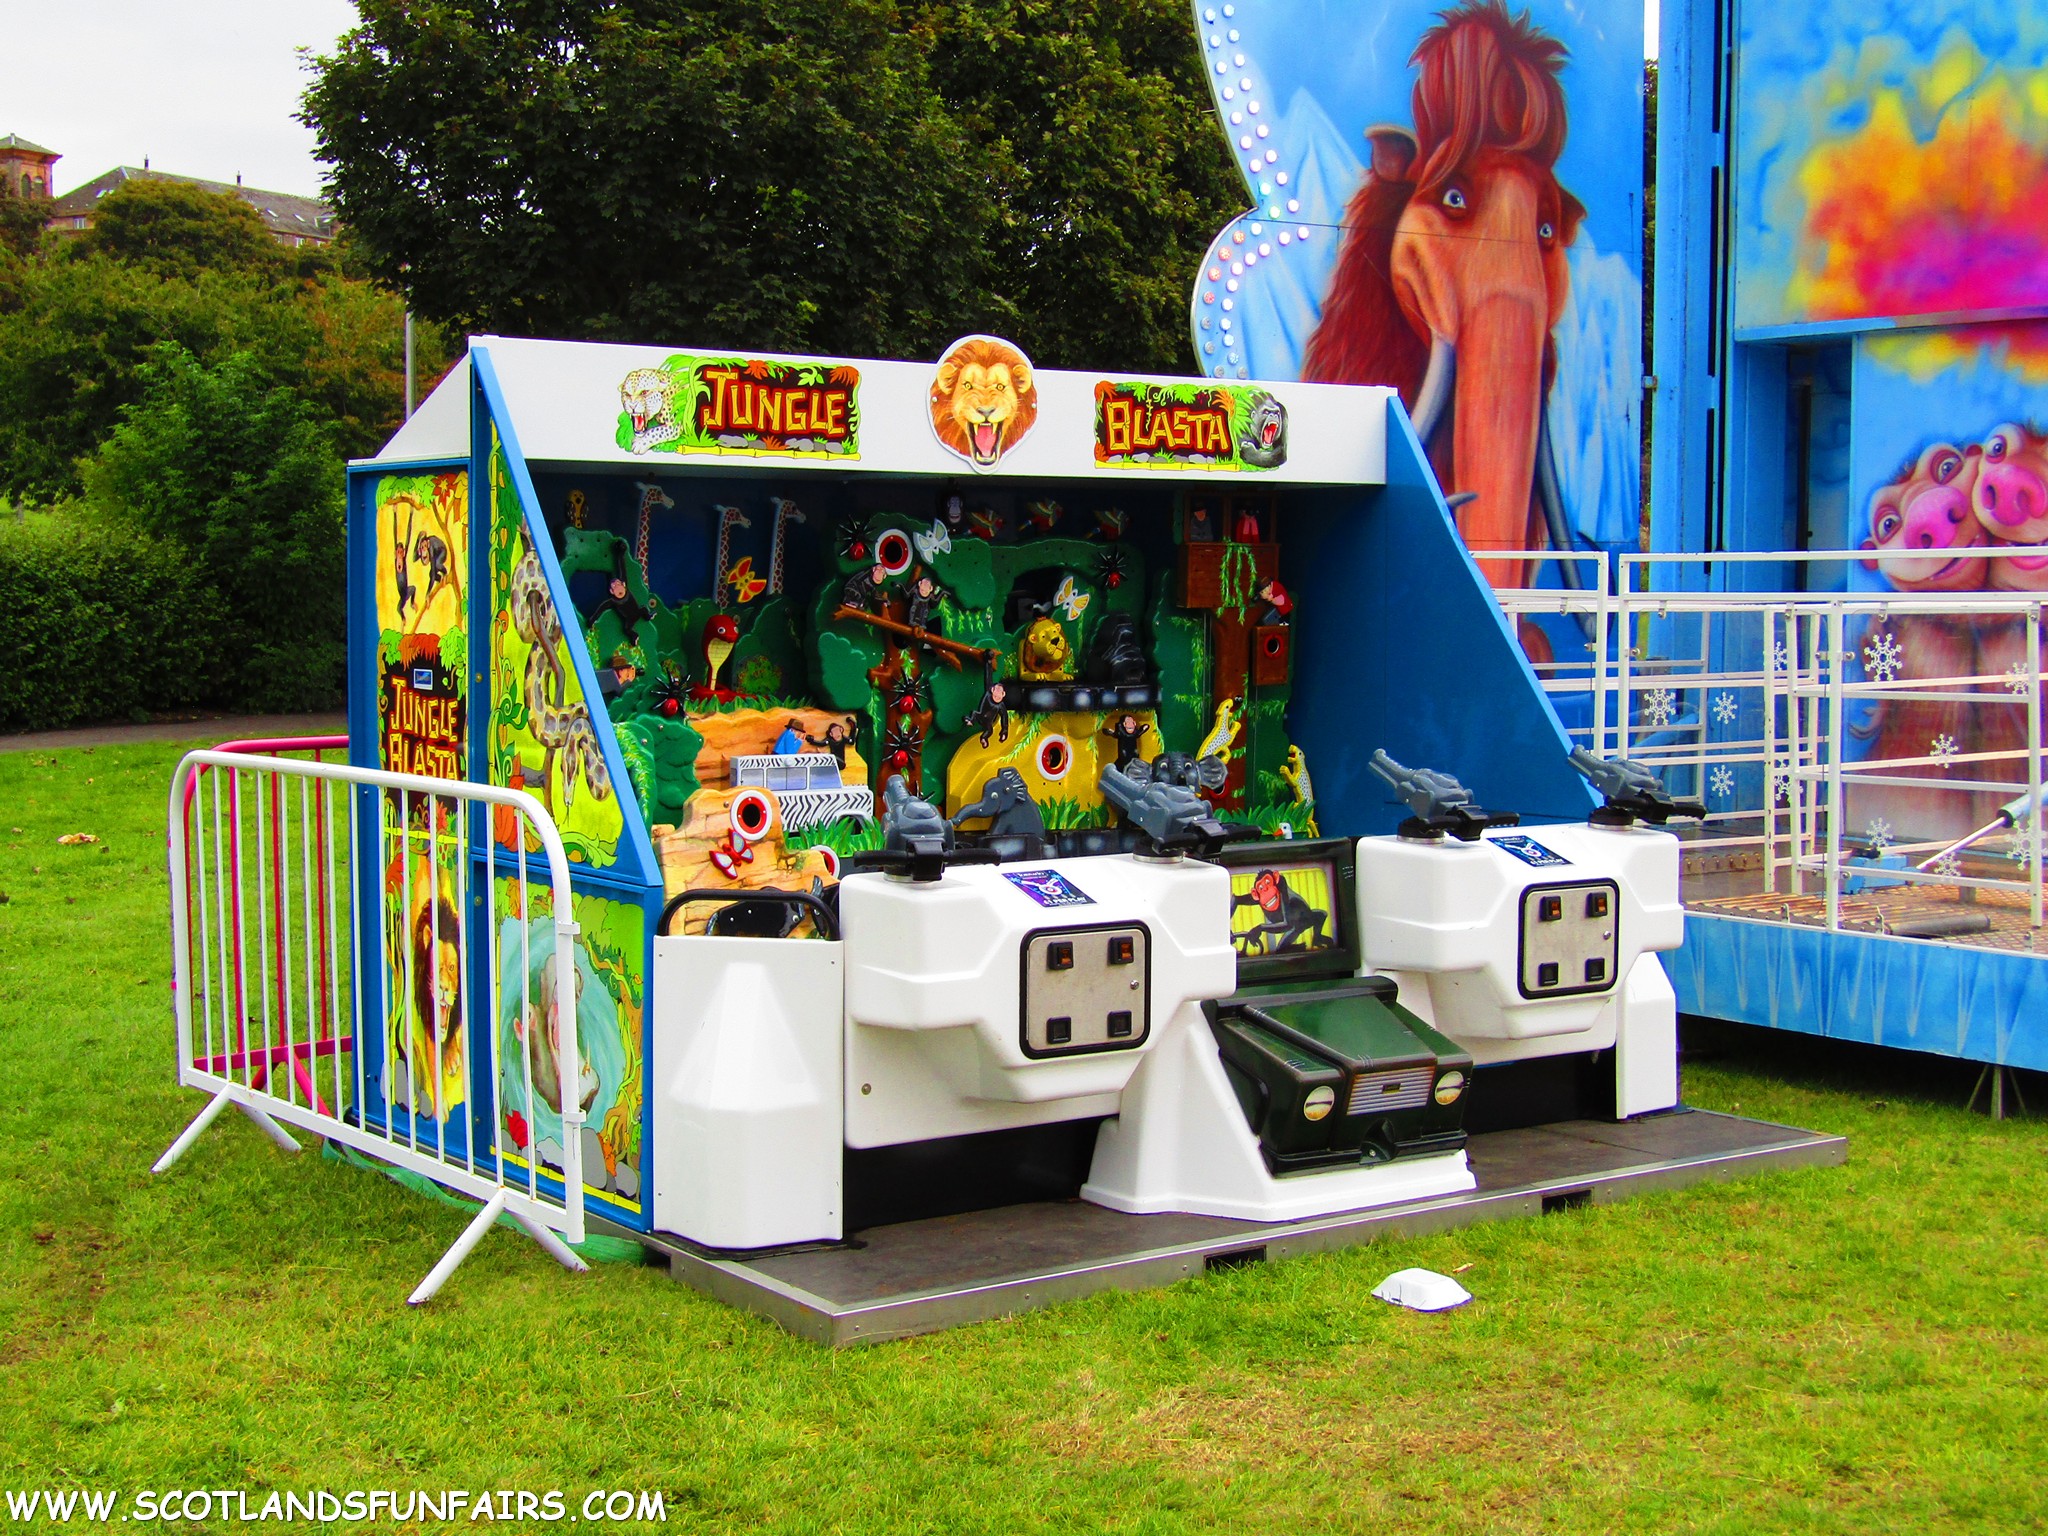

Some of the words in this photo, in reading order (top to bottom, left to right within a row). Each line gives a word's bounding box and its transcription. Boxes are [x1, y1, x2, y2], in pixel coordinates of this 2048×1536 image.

[702, 370, 846, 435] JUNGLE
[1106, 400, 1229, 451] BLASTA
[390, 677, 458, 742] JUNGLE
[389, 732, 459, 780] BLASTA
